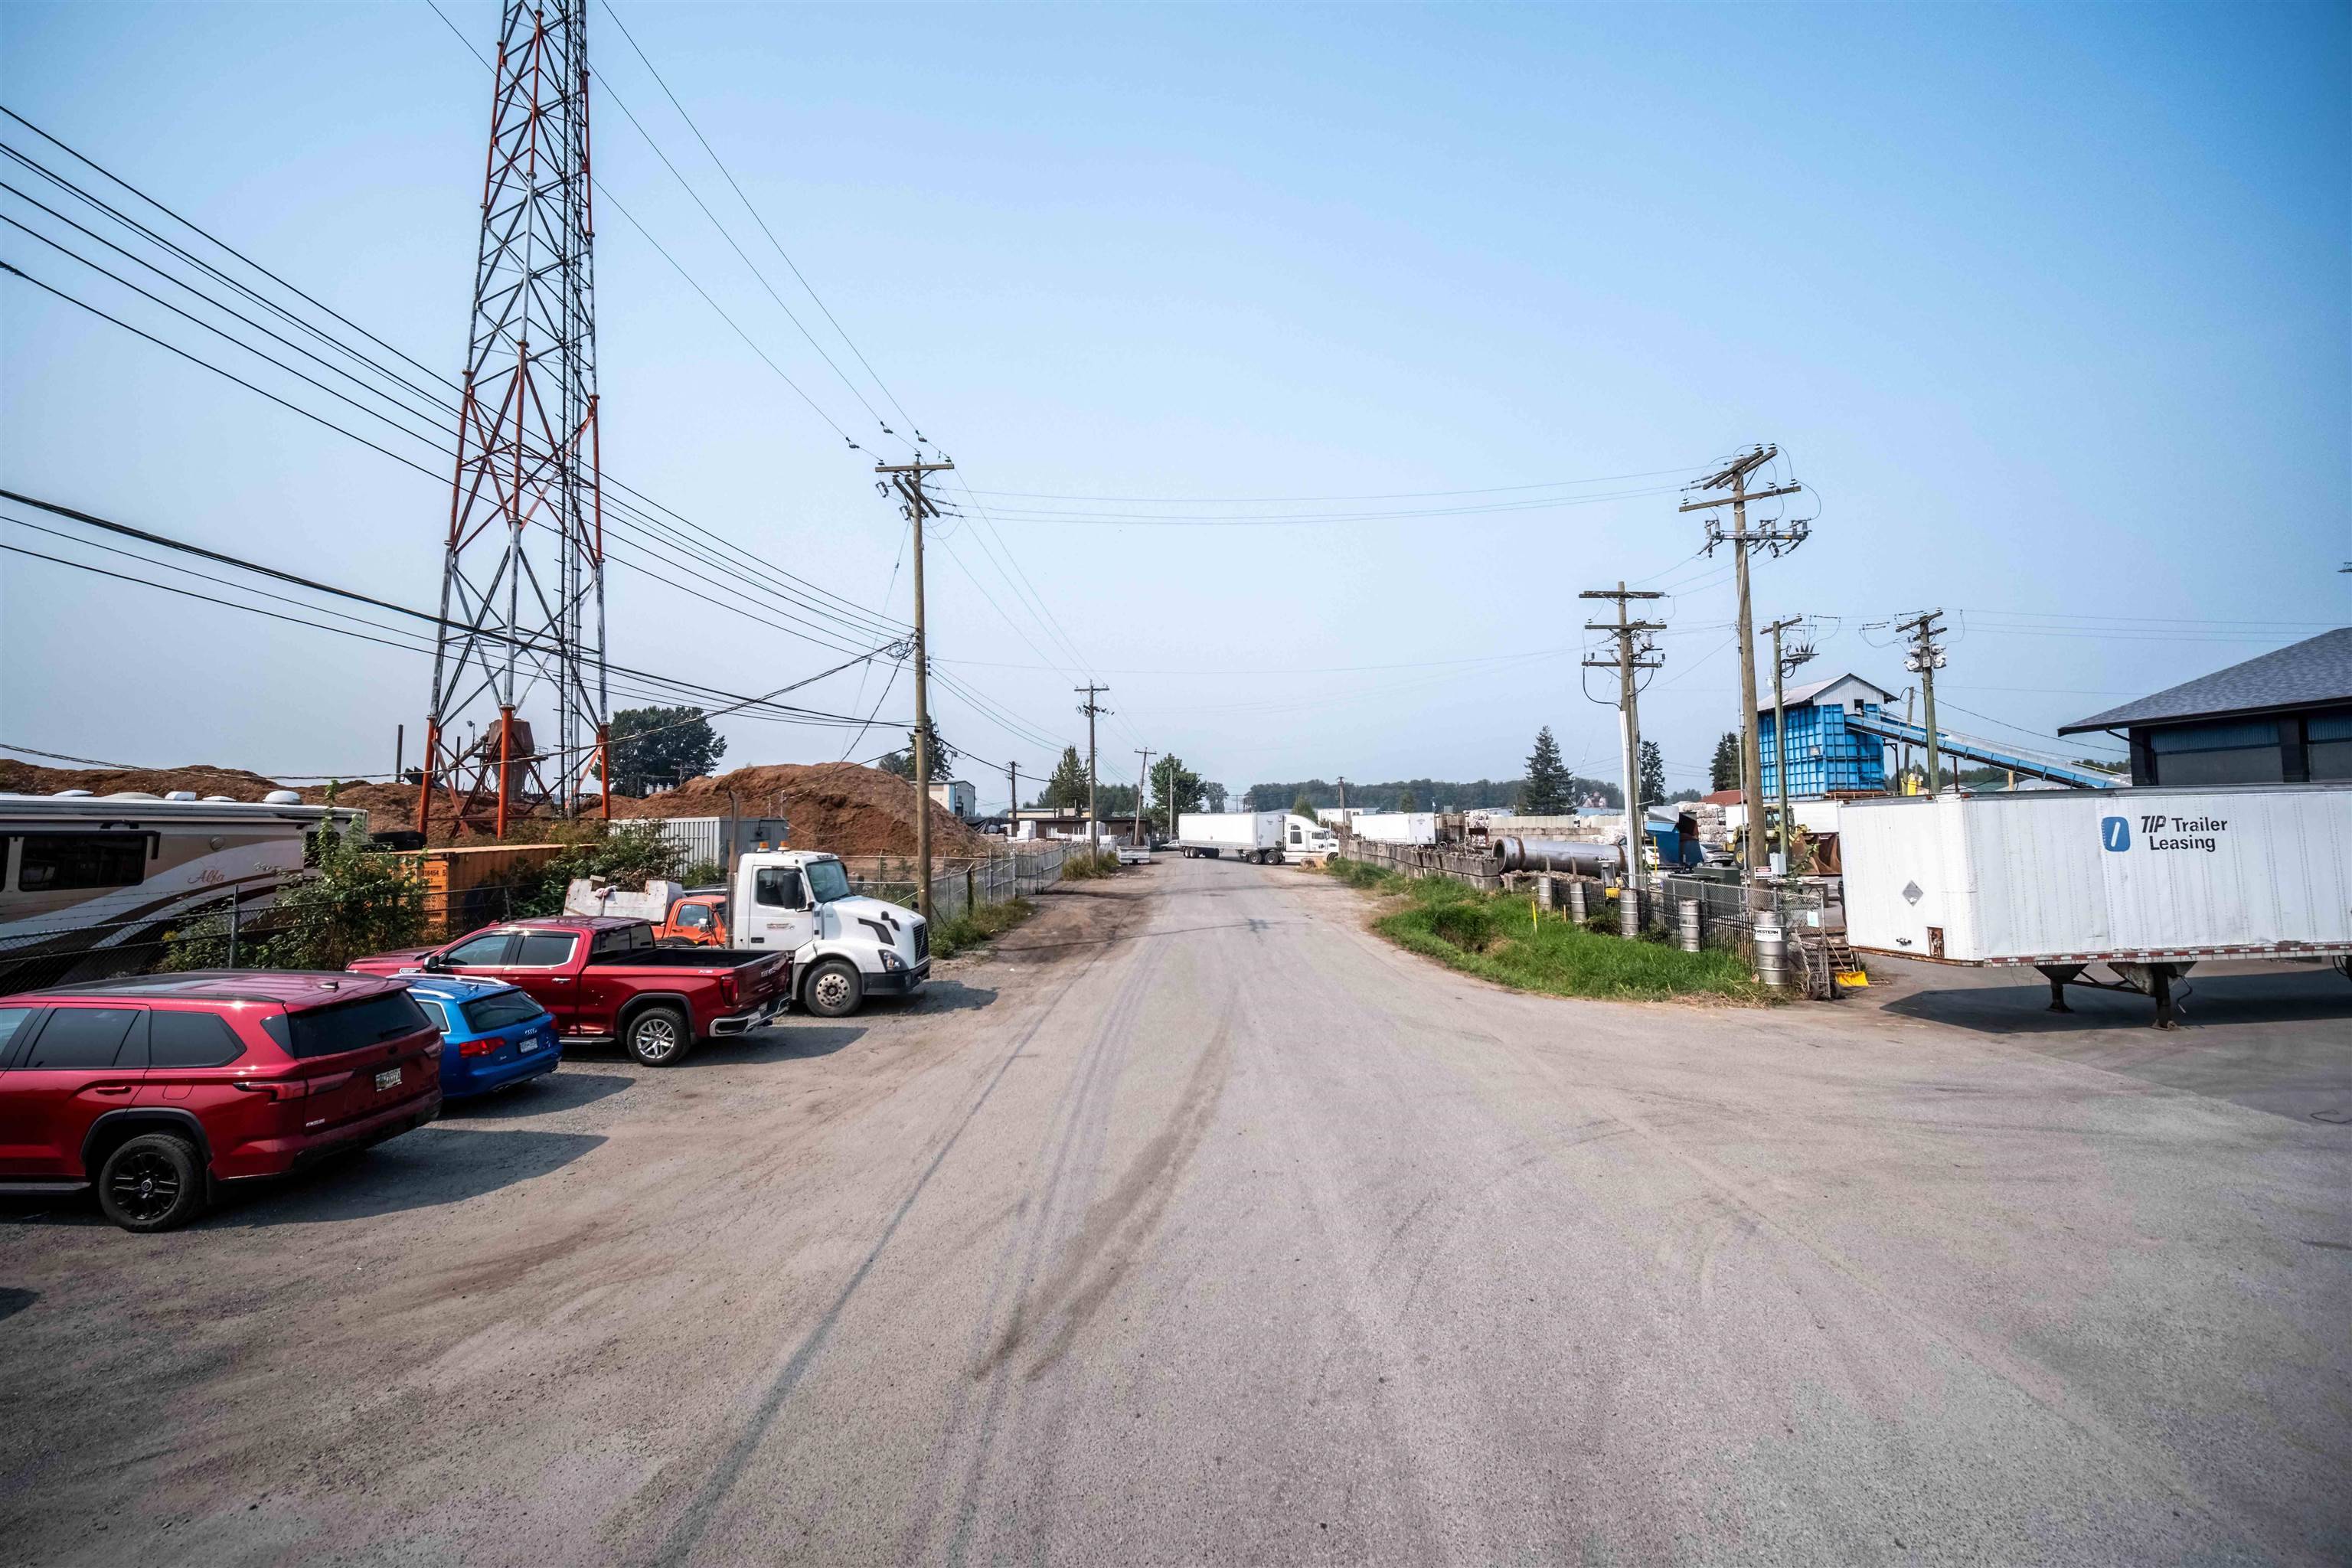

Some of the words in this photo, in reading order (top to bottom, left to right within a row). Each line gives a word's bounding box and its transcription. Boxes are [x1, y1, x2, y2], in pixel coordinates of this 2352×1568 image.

[2141, 815, 2167, 833] TIP
[2171, 817, 2228, 832] Trailer
[2149, 835, 2216, 852] Leasing
[187, 869, 225, 886] Alfa
